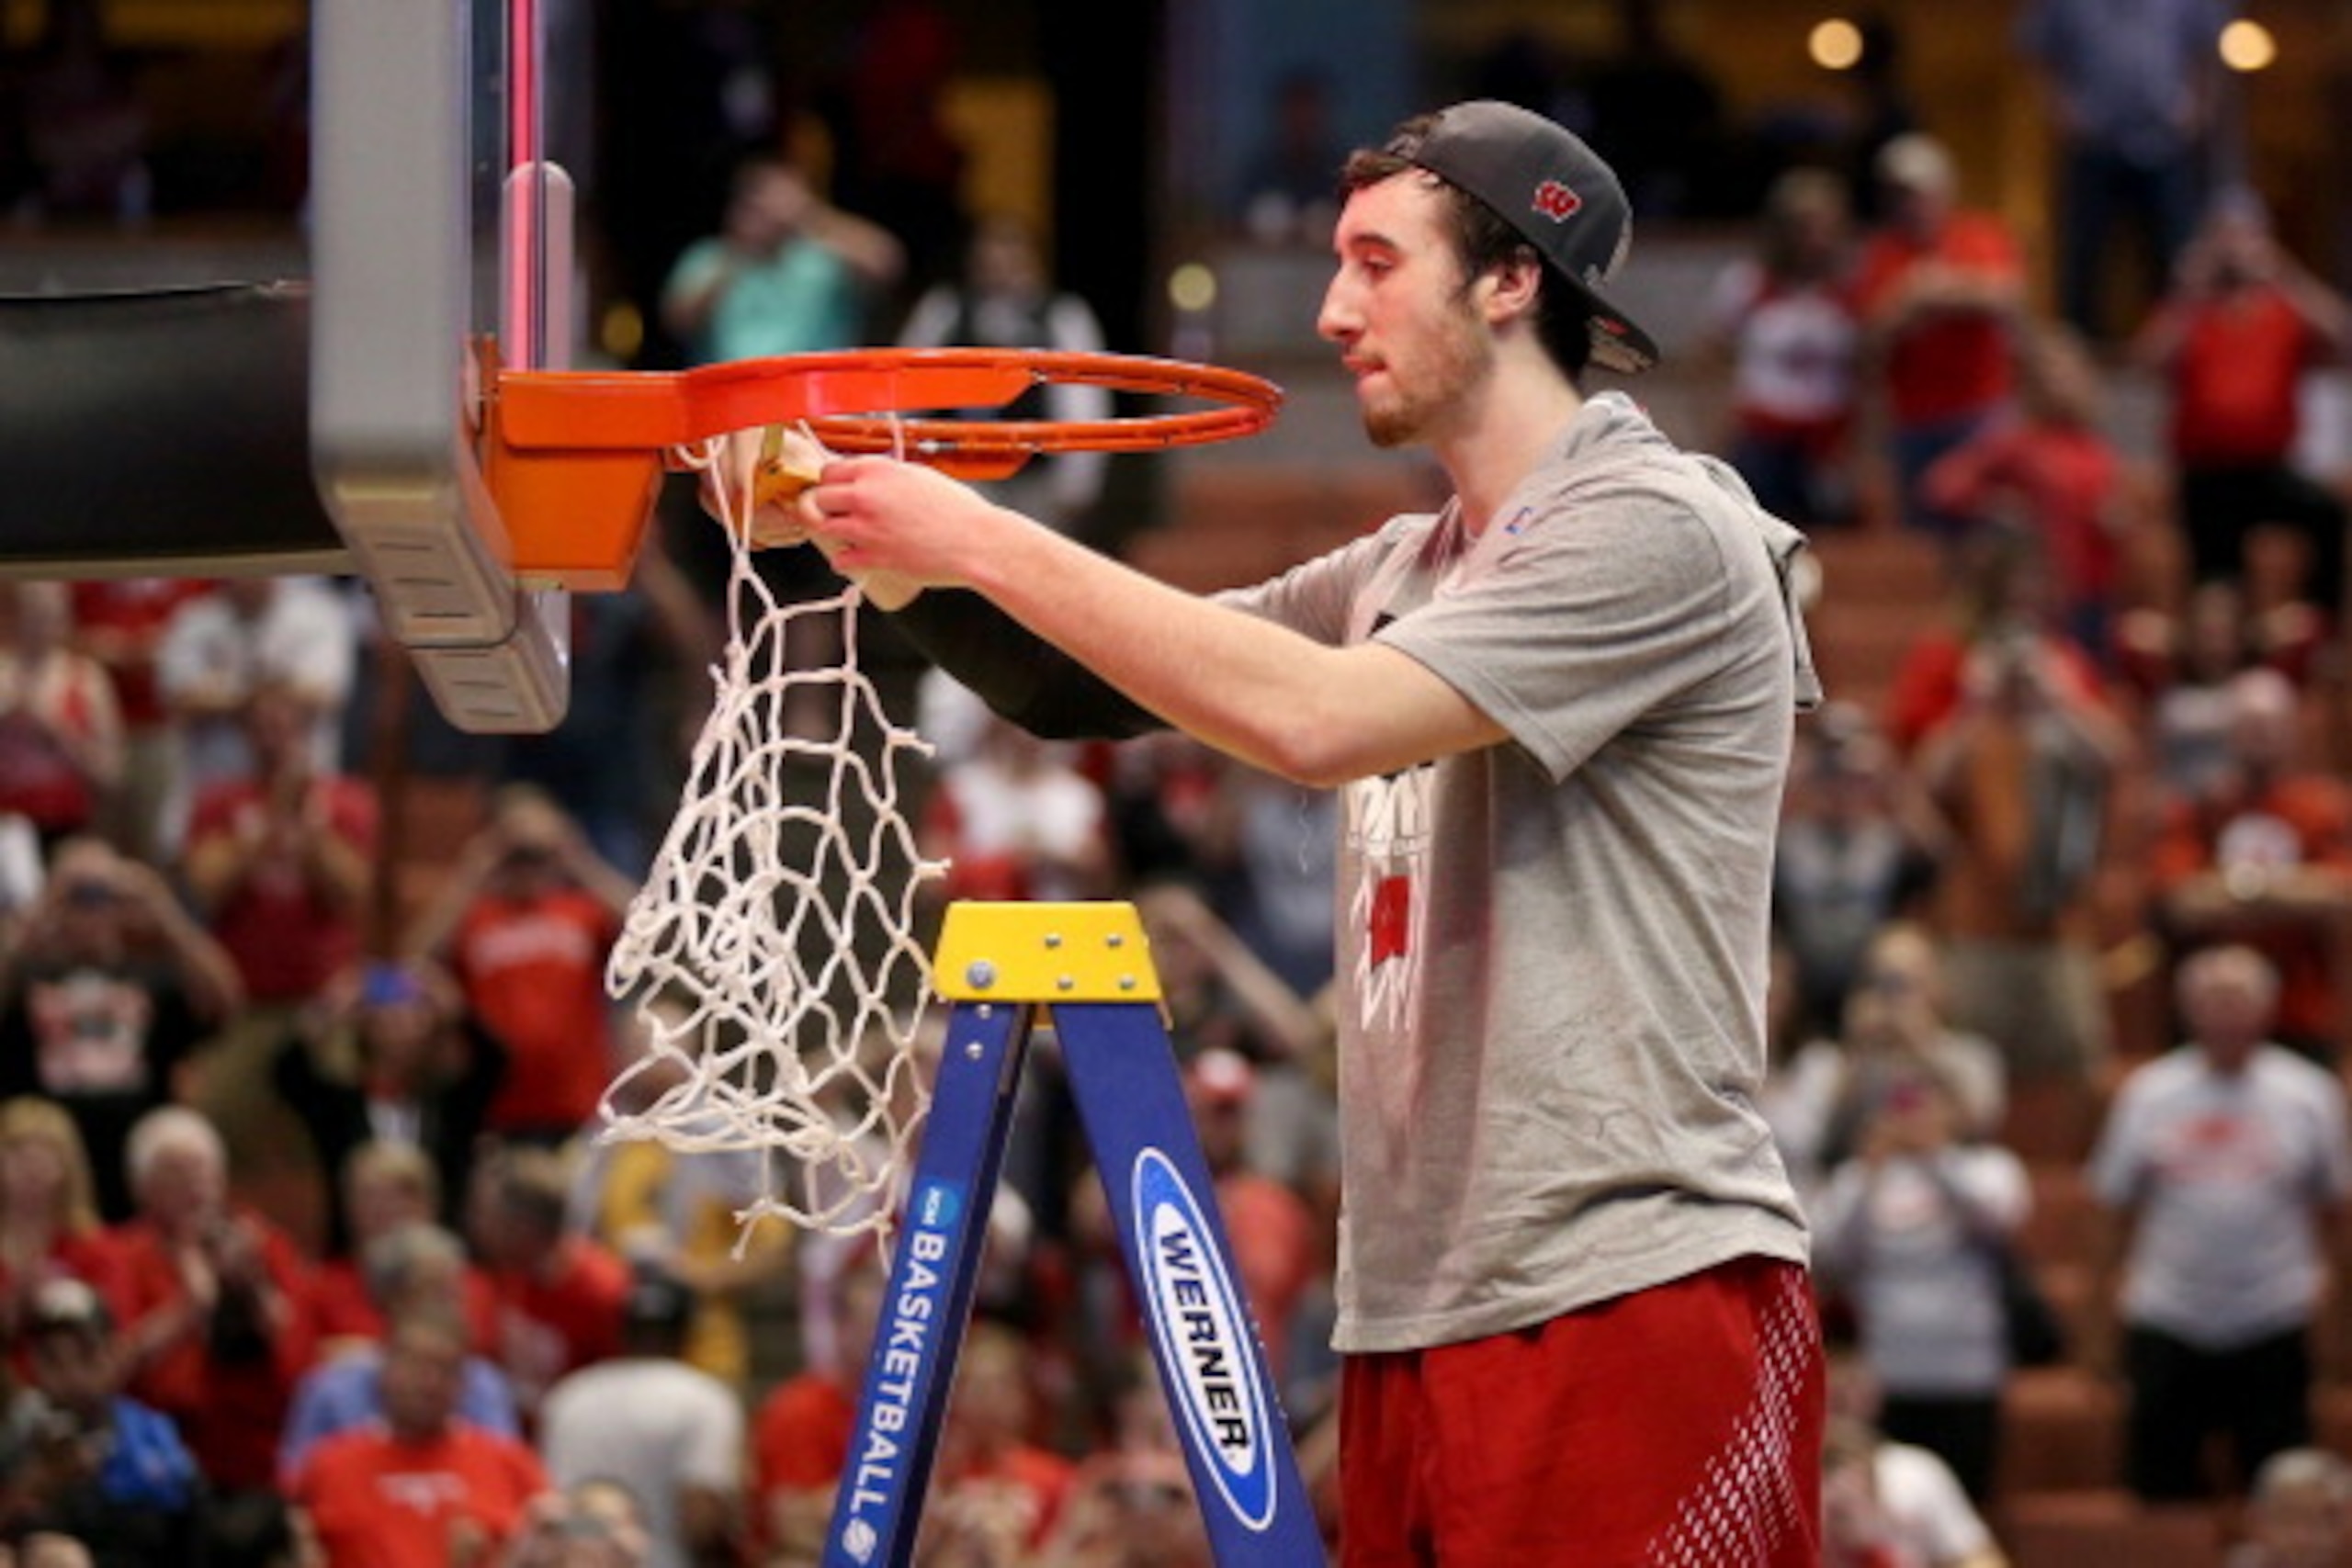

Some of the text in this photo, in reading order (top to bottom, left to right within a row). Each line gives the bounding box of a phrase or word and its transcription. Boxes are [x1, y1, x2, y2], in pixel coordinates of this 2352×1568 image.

[1532, 181, 1581, 222] W
[850, 1230, 945, 1513] BASKETBALL
[1159, 1231, 1250, 1450] WERNER
